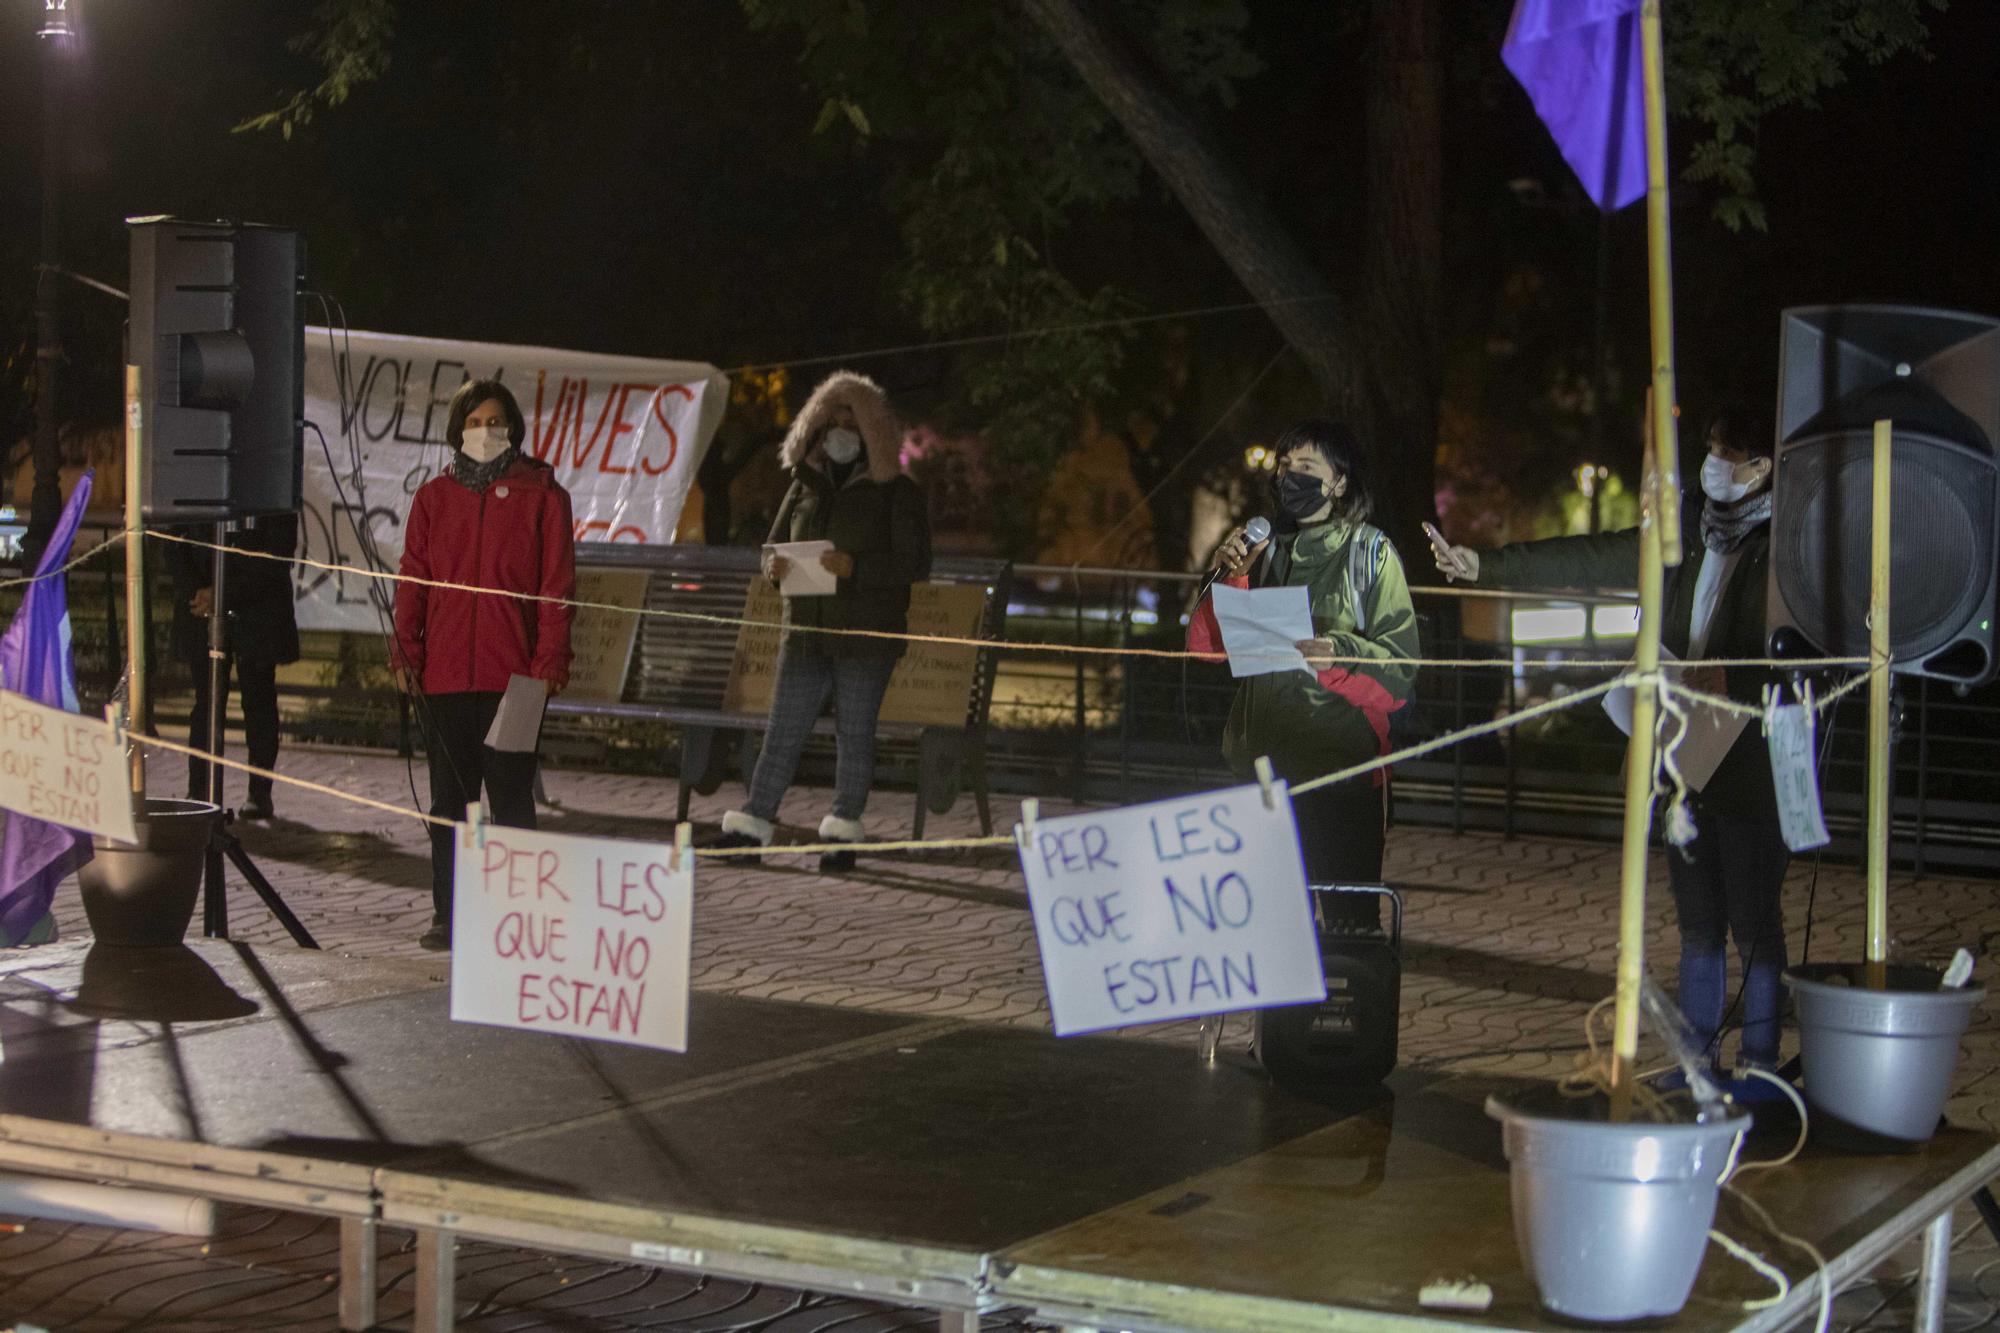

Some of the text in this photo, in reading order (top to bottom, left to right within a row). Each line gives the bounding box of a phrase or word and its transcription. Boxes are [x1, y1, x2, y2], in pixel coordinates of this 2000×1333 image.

[337, 352, 504, 444] VOLE
[1, 703, 109, 765] PER LES
[1, 748, 102, 797] QUE NO
[28, 784, 102, 825] ESTAN
[1037, 803, 1243, 879] PER LES
[481, 839, 671, 922] PER LES
[1049, 870, 1254, 947] QUE NO
[494, 912, 652, 981] QUE NO
[517, 973, 647, 1035] ESTAN
[1103, 952, 1259, 1014] ESTAN
